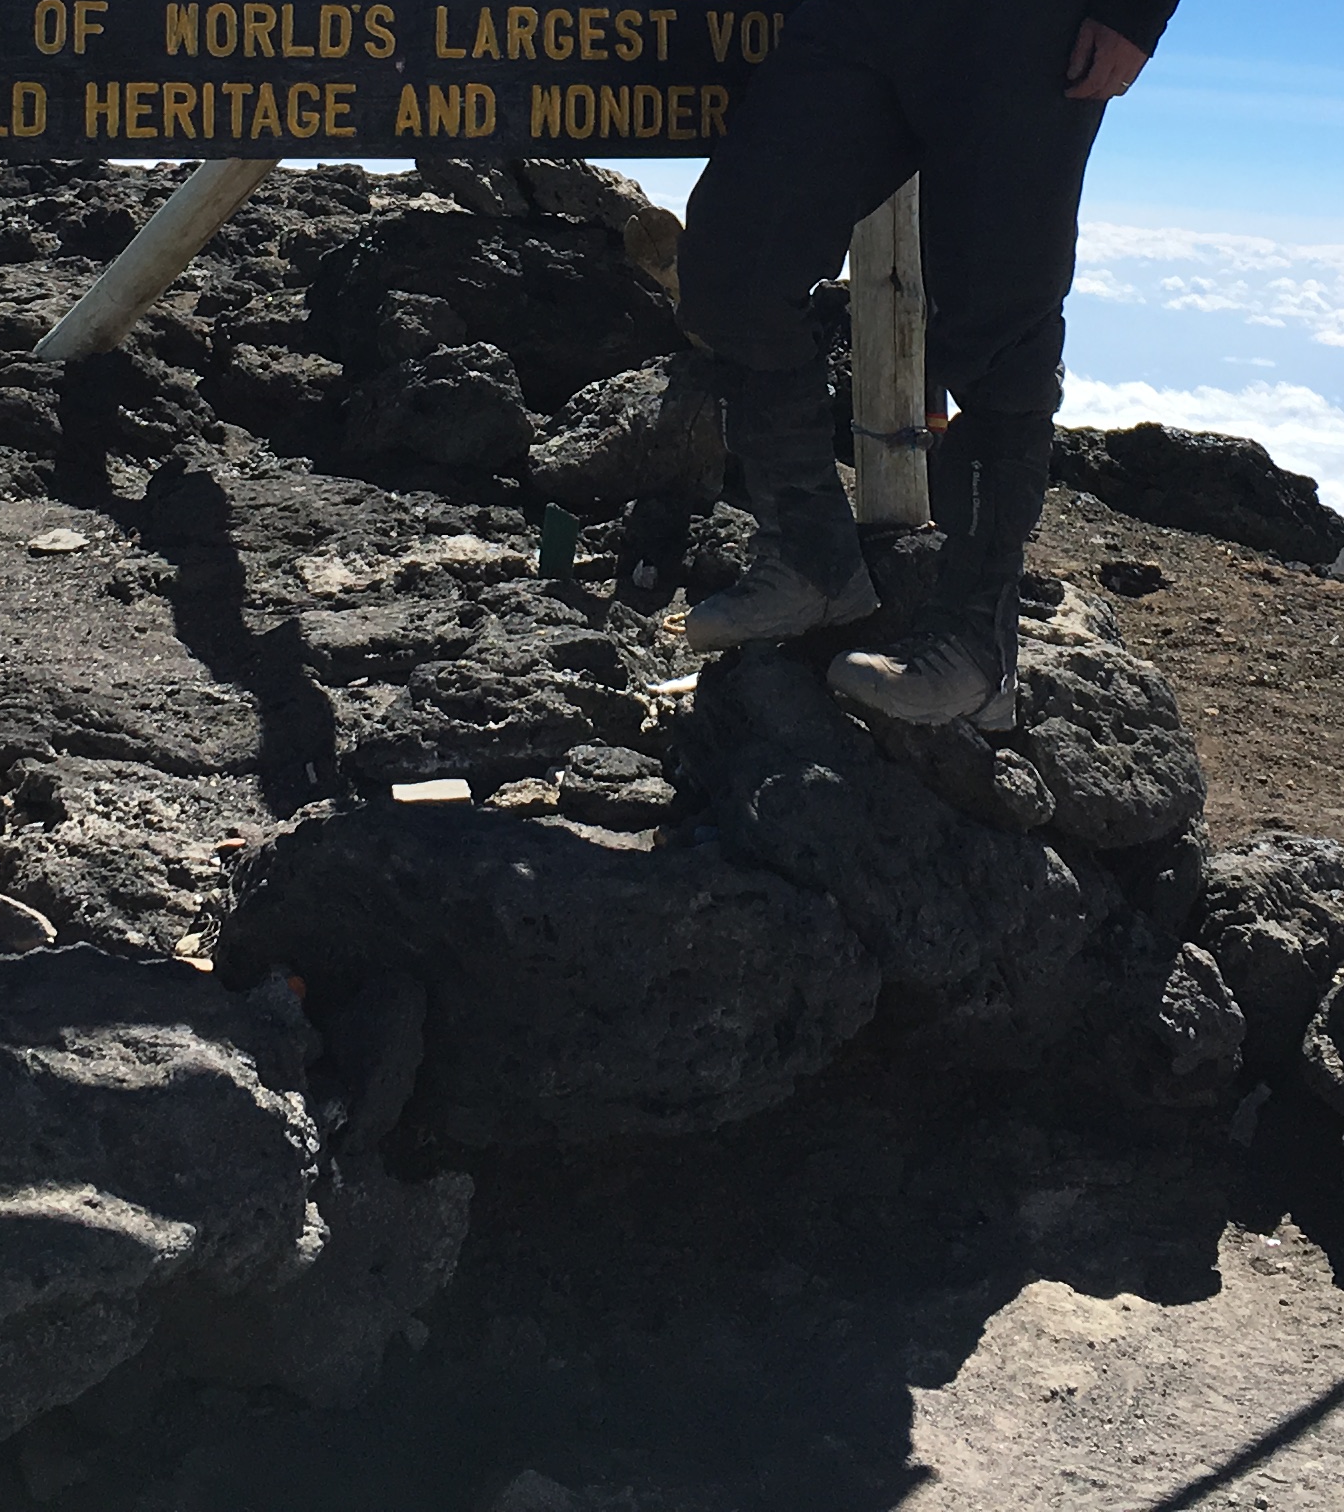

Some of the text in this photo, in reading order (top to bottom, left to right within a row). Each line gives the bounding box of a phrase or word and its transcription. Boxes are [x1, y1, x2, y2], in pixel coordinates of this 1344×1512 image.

[165, 2, 396, 59] WORLD'S
[435, 5, 676, 61] LARGEST
[84, 81, 357, 139] HERITAGE
[394, 82, 497, 138] AND
[530, 83, 729, 139] WONDER
